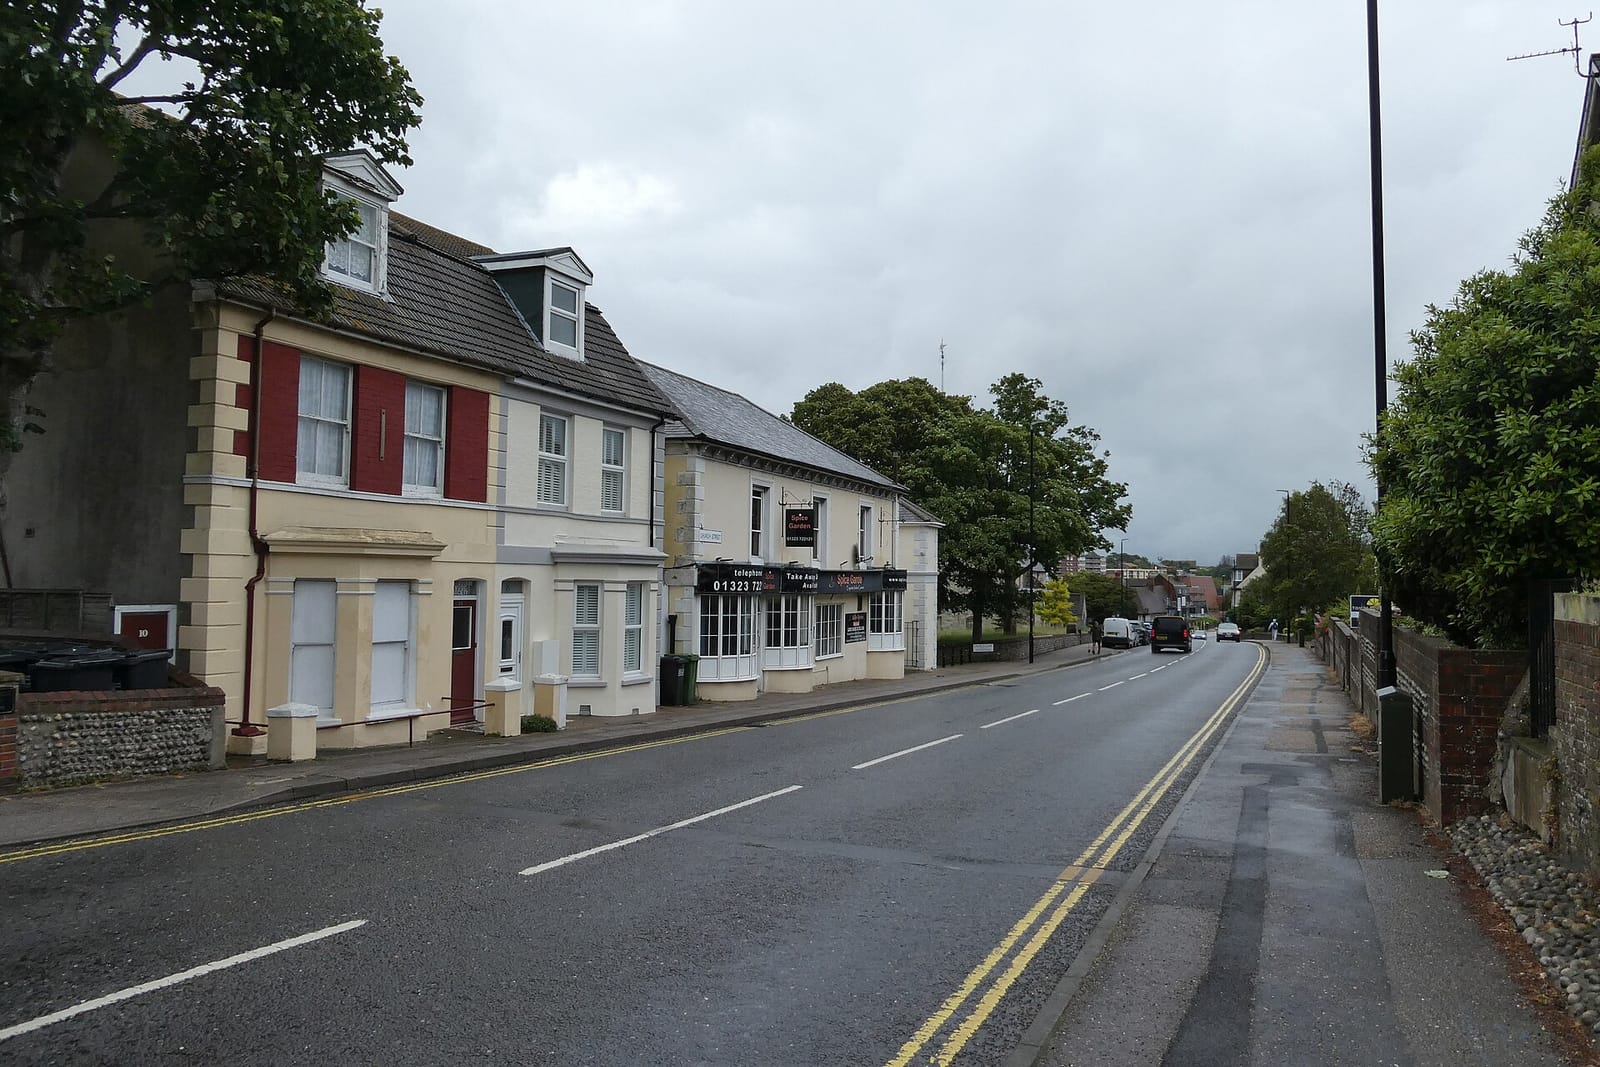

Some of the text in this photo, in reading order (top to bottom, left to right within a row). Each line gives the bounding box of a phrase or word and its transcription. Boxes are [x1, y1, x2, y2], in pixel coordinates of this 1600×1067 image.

[791, 514, 808, 522] Spice
[786, 572, 803, 580] Take
[837, 573, 850, 586] Spice
[713, 580, 749, 591] 01323
[138, 629, 149, 638] 10
